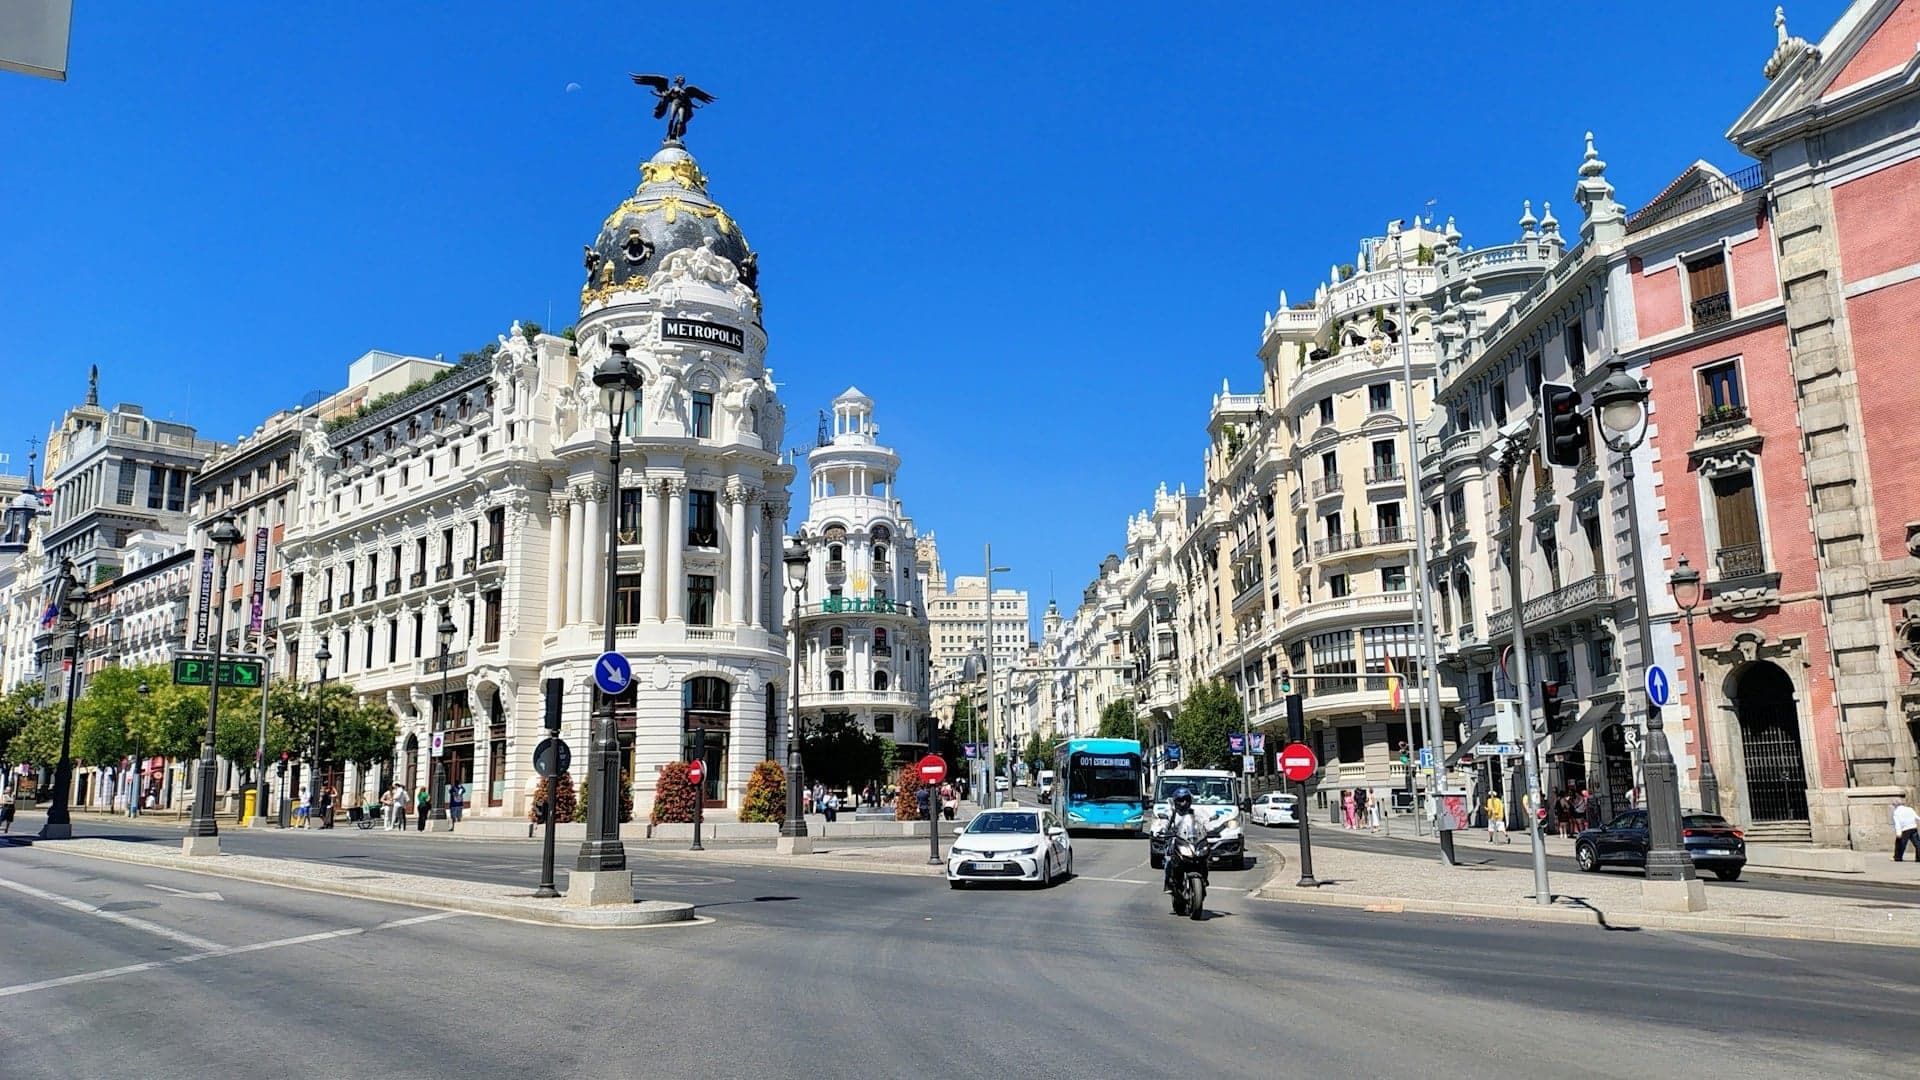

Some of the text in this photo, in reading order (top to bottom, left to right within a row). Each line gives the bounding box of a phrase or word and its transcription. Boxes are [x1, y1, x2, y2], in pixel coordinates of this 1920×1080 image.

[667, 323, 741, 346] METROPOLIS
[198, 572, 211, 644] POR SER MUJERES
[821, 597, 897, 613] ROLEX
[187, 663, 198, 677] P
[1080, 757, 1093, 766] 001
